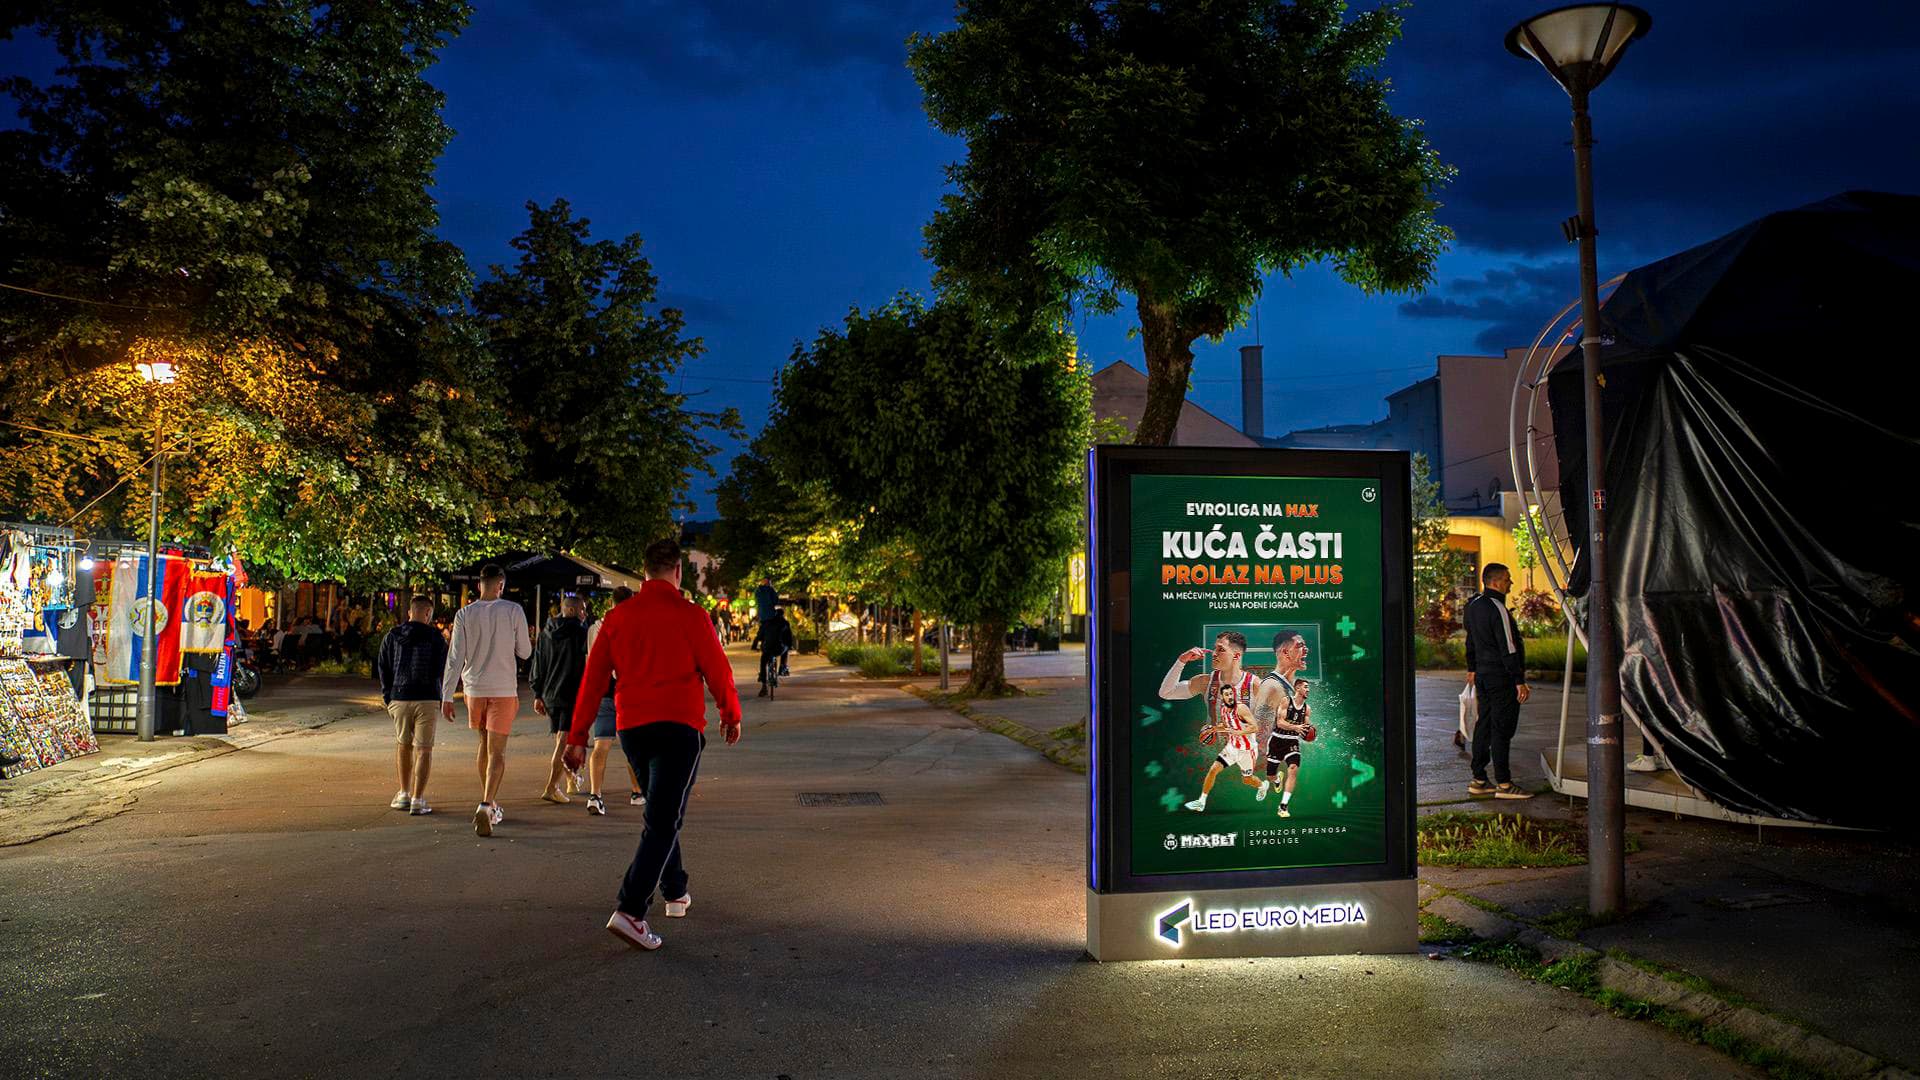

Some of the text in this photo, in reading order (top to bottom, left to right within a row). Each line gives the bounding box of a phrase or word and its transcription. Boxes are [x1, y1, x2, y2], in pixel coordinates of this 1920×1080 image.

[1186, 503, 1319, 518] EVROLIGA NA MAX
[1162, 524, 1343, 559] KUĆA ČASTI
[1162, 565, 1344, 584] PROLAZ NA PLUS
[1162, 592, 1175, 600] NA
[1176, 590, 1218, 600] MEČEVIMA
[1218, 590, 1252, 600] VJEČITIH
[1253, 592, 1271, 600] PRVI
[1272, 590, 1289, 600] KOŠ
[1299, 592, 1343, 600] GARANTUJE
[1208, 599, 1300, 609] PLUS NA POENE IGRAČA
[1249, 826, 1348, 837] SPONZOR PRENOSA
[1181, 832, 1238, 848] MAXBET
[1249, 837, 1300, 845] EVROLIGE
[1195, 906, 1366, 930] LED EURO MEDIA
